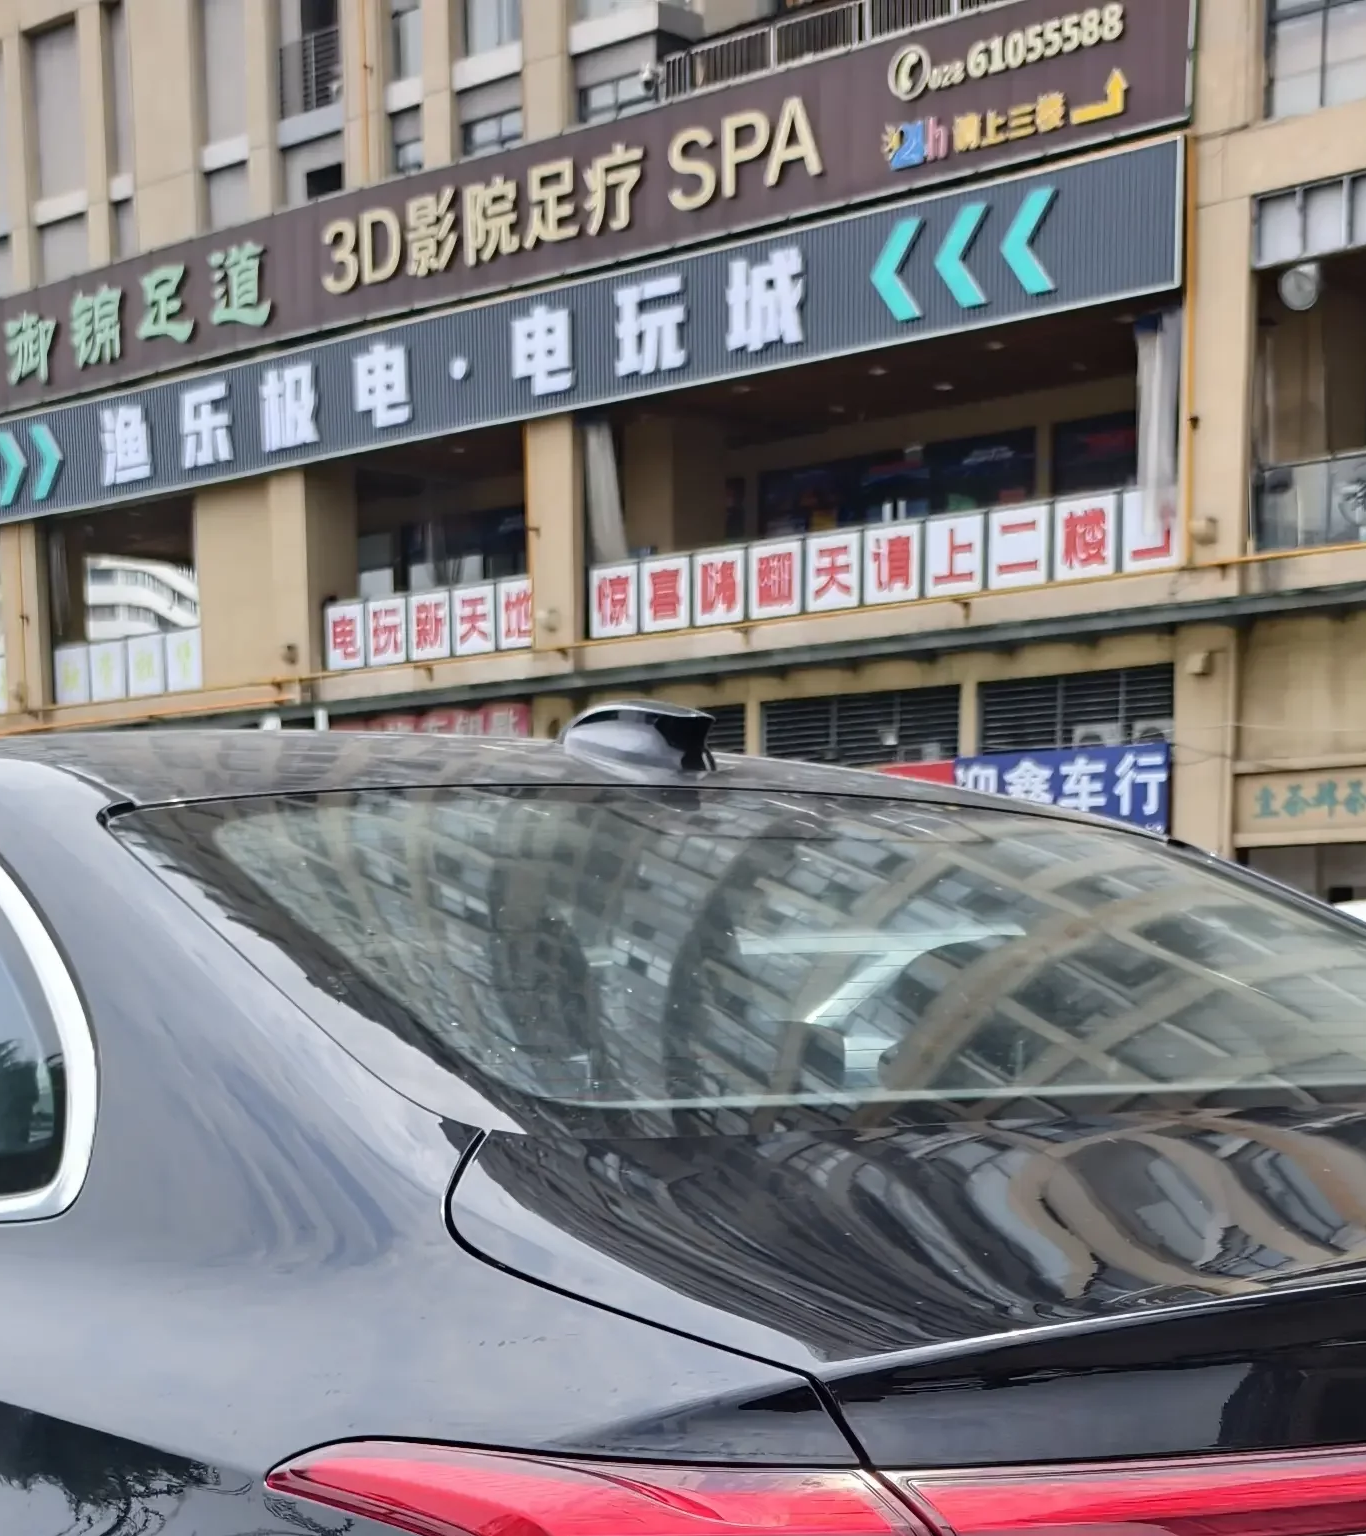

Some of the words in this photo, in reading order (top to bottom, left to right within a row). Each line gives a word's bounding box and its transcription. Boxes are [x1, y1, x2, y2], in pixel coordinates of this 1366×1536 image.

[967, 3, 1124, 78] 61055588
[5, 241, 272, 385] 御锦足道
[321, 142, 645, 294] 3D影院足疗
[668, 96, 824, 211] SPA
[332, 589, 532, 661] 电玩新天地
